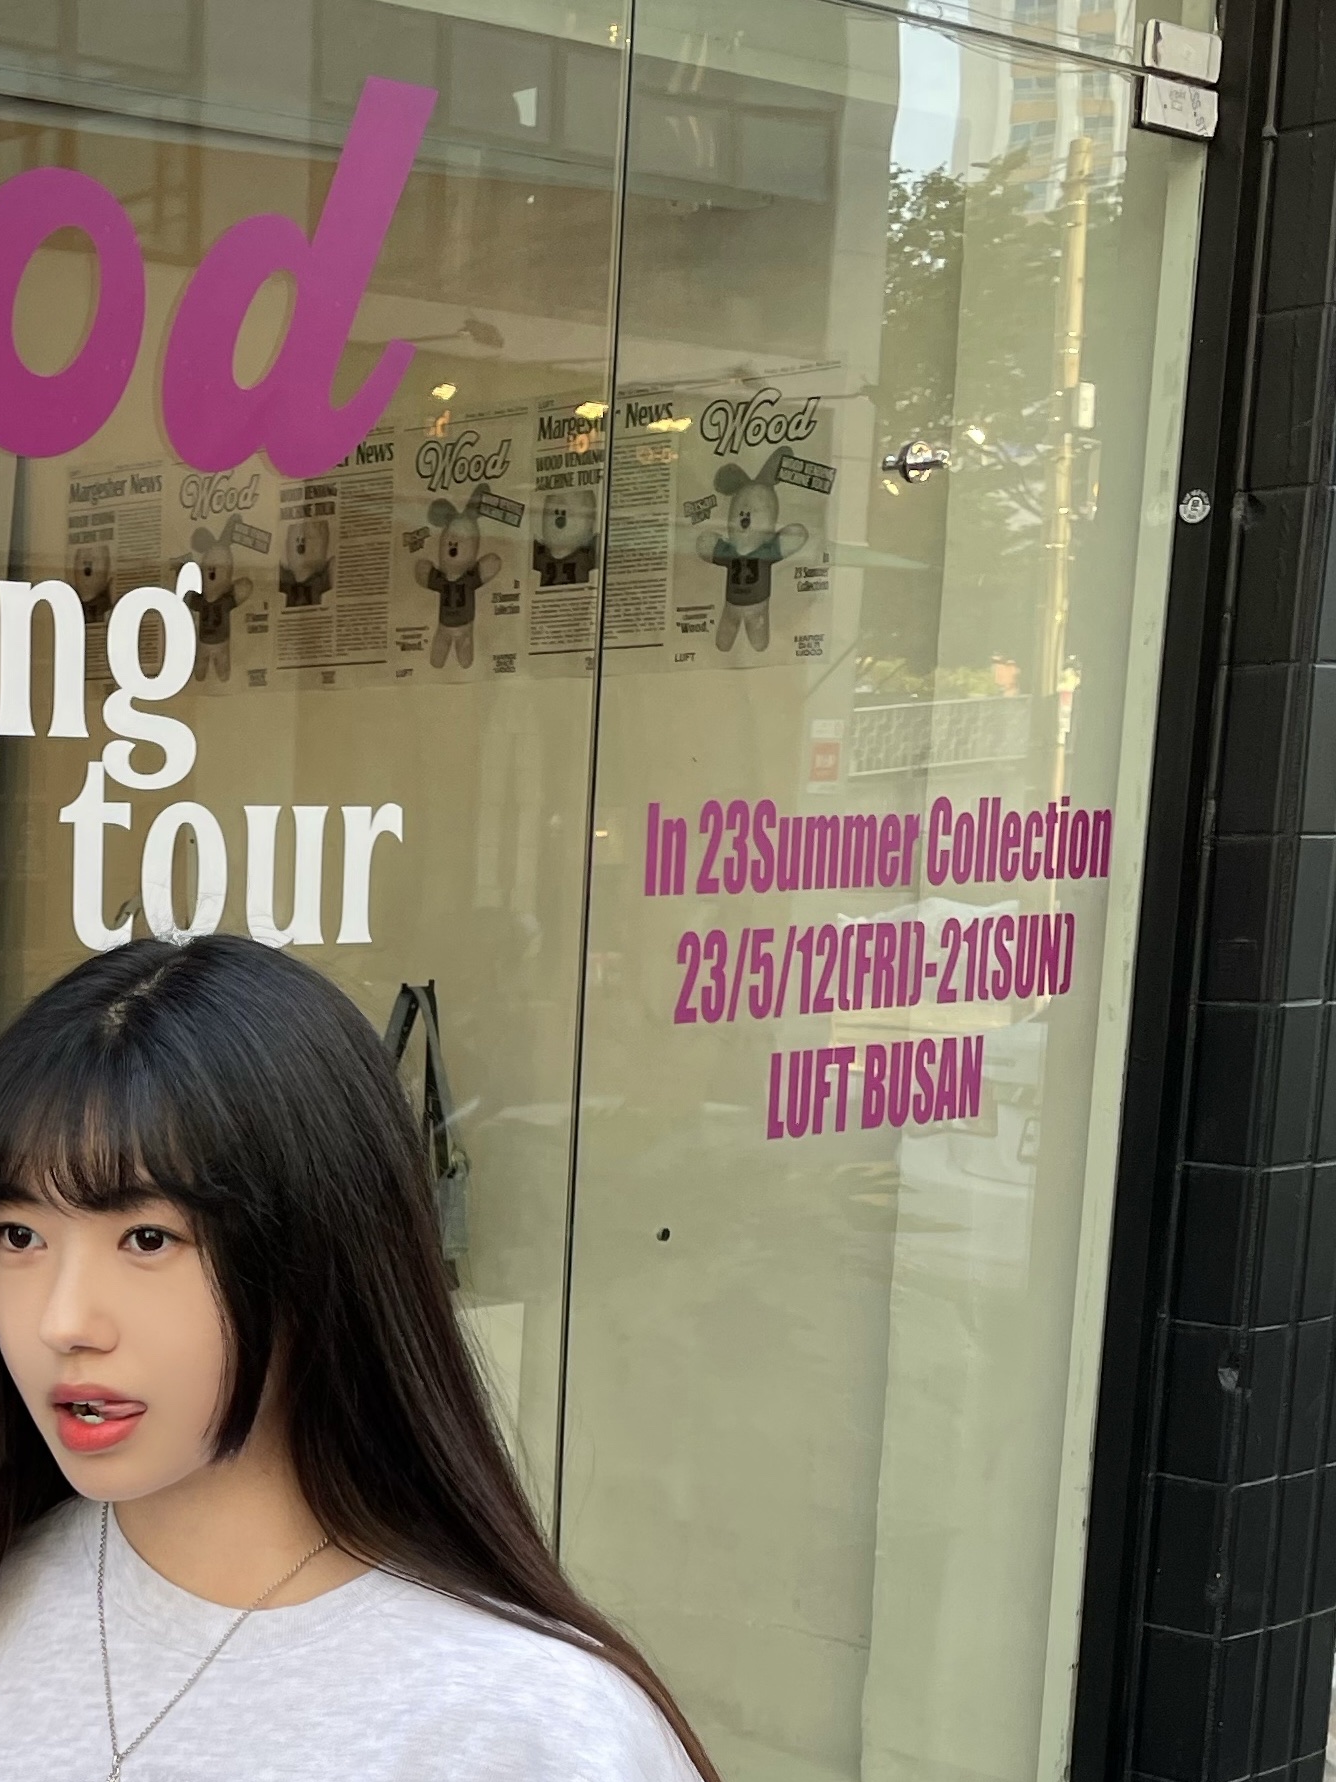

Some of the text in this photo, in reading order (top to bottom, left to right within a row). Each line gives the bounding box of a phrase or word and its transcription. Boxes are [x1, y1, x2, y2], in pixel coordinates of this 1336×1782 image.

[416, 430, 512, 492] Wood
[700, 387, 821, 456] Wood
[180, 470, 261, 521] Wood
[58, 760, 404, 952] tour
[644, 801, 686, 897] In
[927, 796, 1112, 886] Collection
[767, 1035, 984, 1140] LUFT BUSAN
